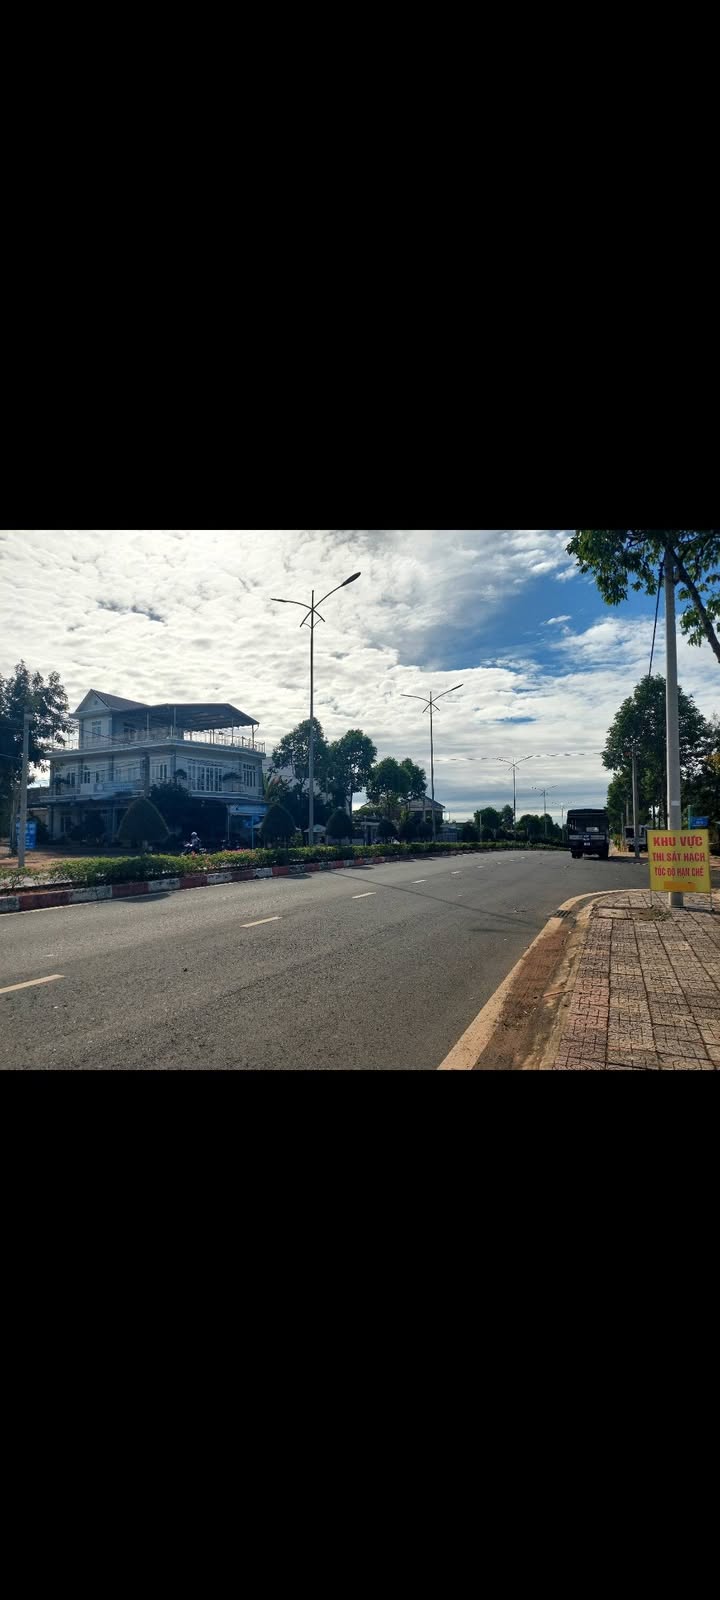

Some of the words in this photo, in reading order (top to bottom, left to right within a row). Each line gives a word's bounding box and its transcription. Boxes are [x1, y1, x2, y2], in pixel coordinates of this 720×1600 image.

[653, 836, 676, 847] KHU
[680, 835, 703, 848] VỰC
[652, 852, 664, 862] THI
[666, 851, 681, 862] SÁT
[684, 852, 705, 863] HẠCH
